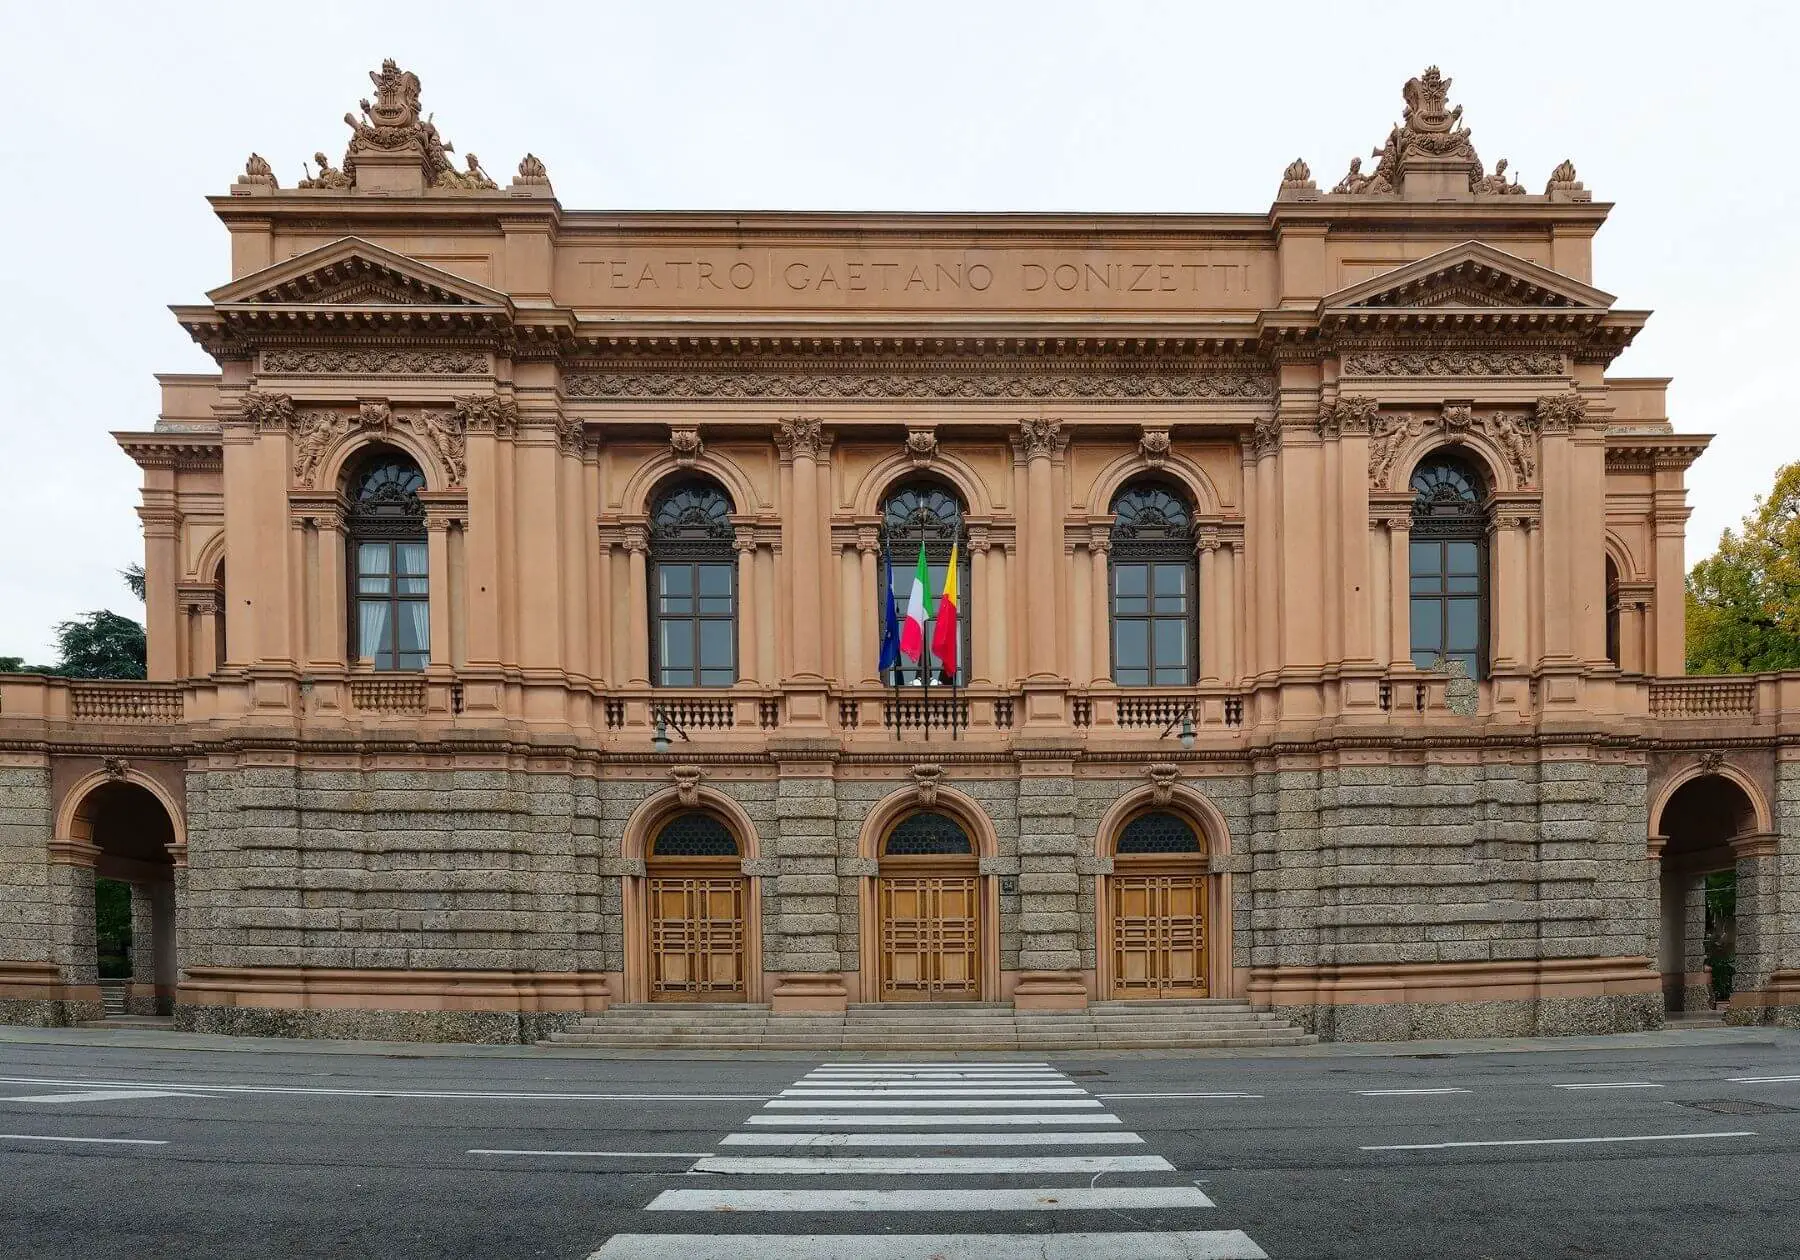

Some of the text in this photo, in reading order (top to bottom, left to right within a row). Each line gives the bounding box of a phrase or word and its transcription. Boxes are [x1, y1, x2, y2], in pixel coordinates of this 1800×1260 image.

[578, 260, 1251, 292] TEATRO GAETANO DONIZETTI
